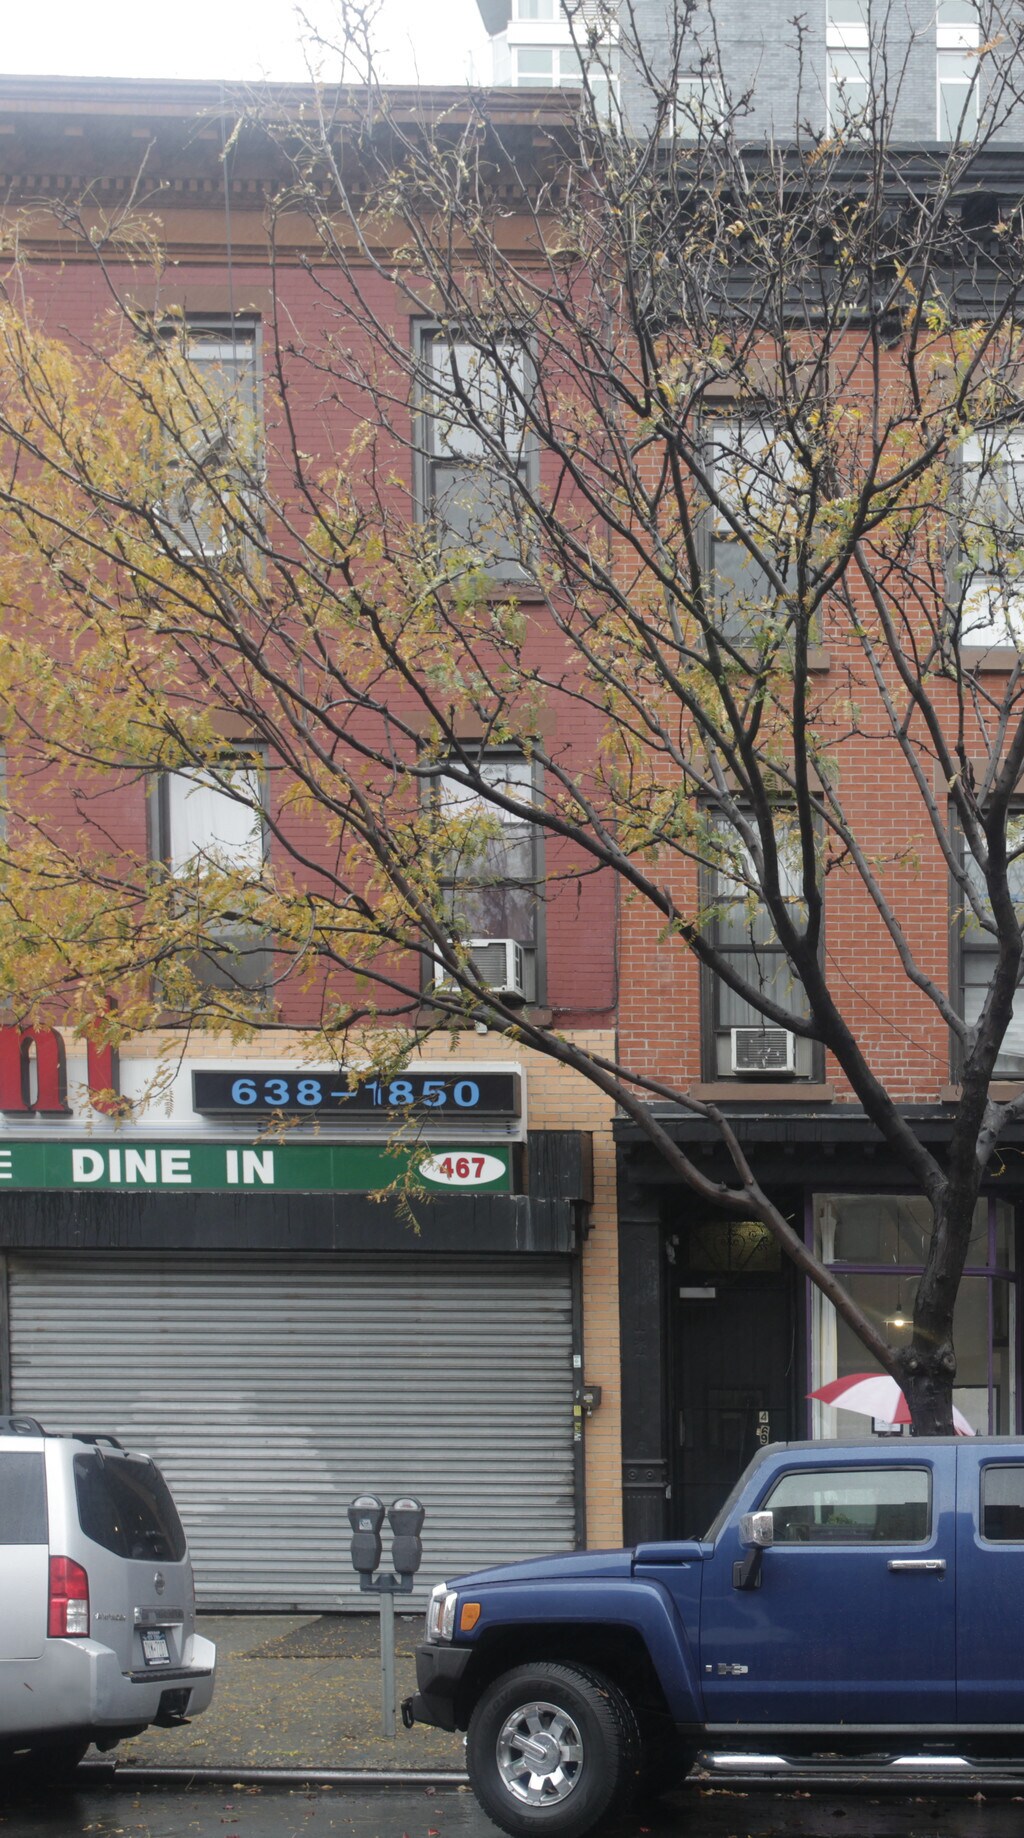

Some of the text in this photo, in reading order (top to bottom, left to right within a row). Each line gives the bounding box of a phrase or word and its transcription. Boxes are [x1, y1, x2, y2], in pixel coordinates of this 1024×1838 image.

[72, 1149, 275, 1184] DINE IN
[439, 1157, 485, 1178] 467
